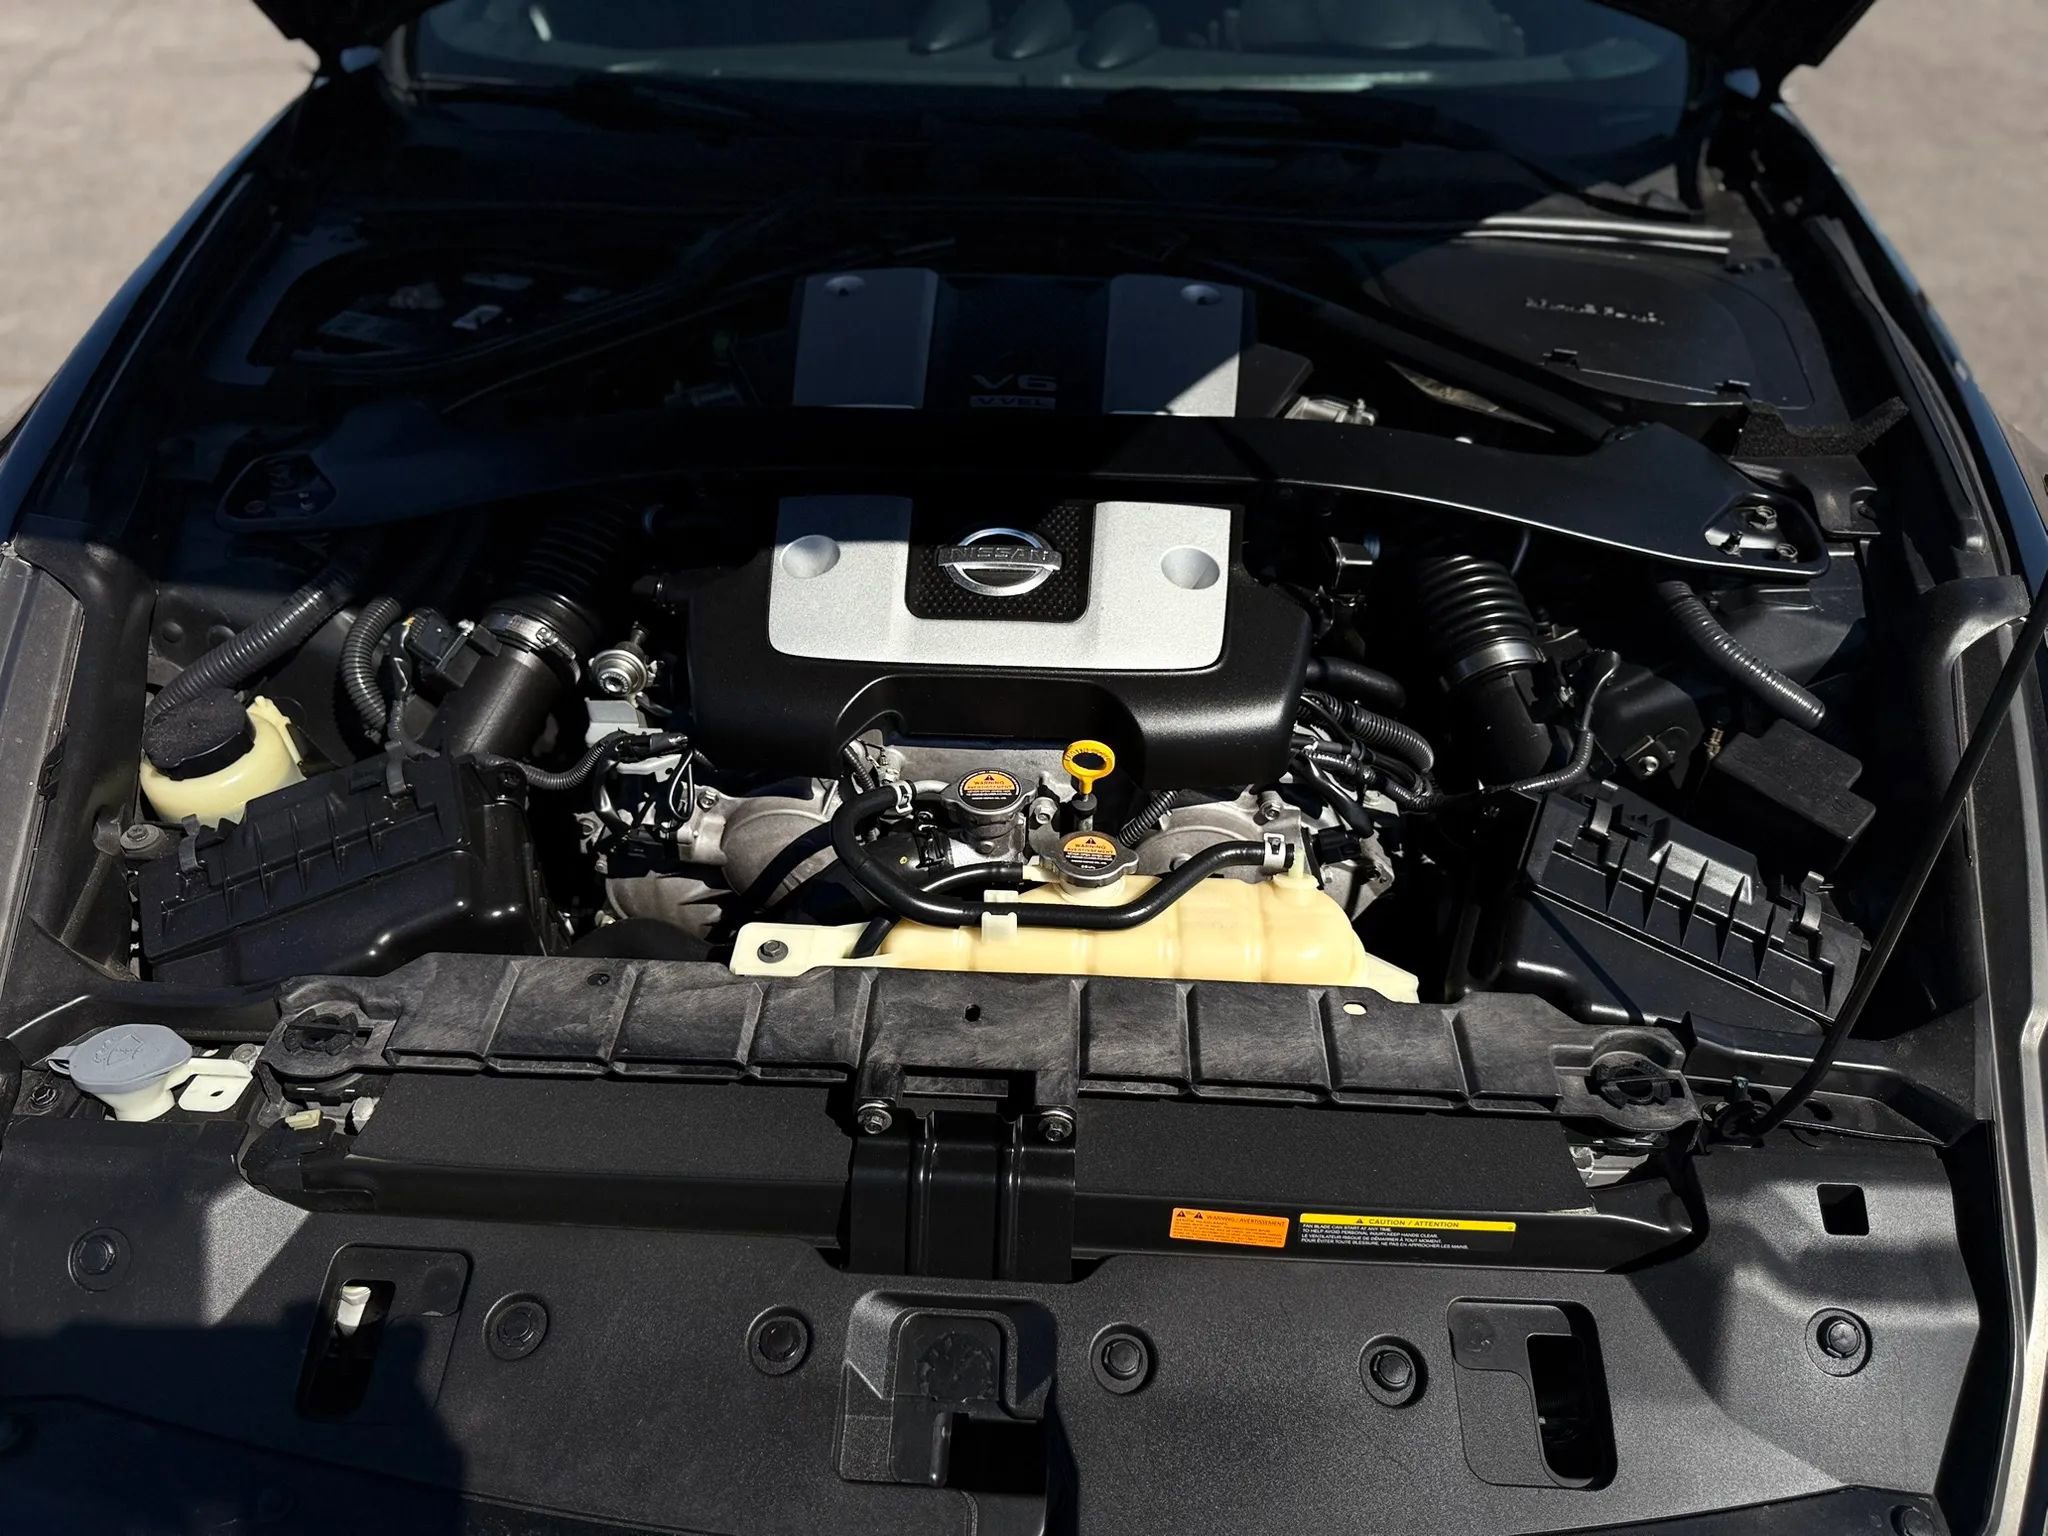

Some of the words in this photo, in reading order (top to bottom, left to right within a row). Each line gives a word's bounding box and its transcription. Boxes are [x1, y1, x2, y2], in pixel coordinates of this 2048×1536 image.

[971, 373, 1057, 392] V6
[950, 546, 1049, 561] NISSAN
[1369, 1218, 1406, 1226] CAUTION
[1414, 1220, 1460, 1228] ATTENTION
